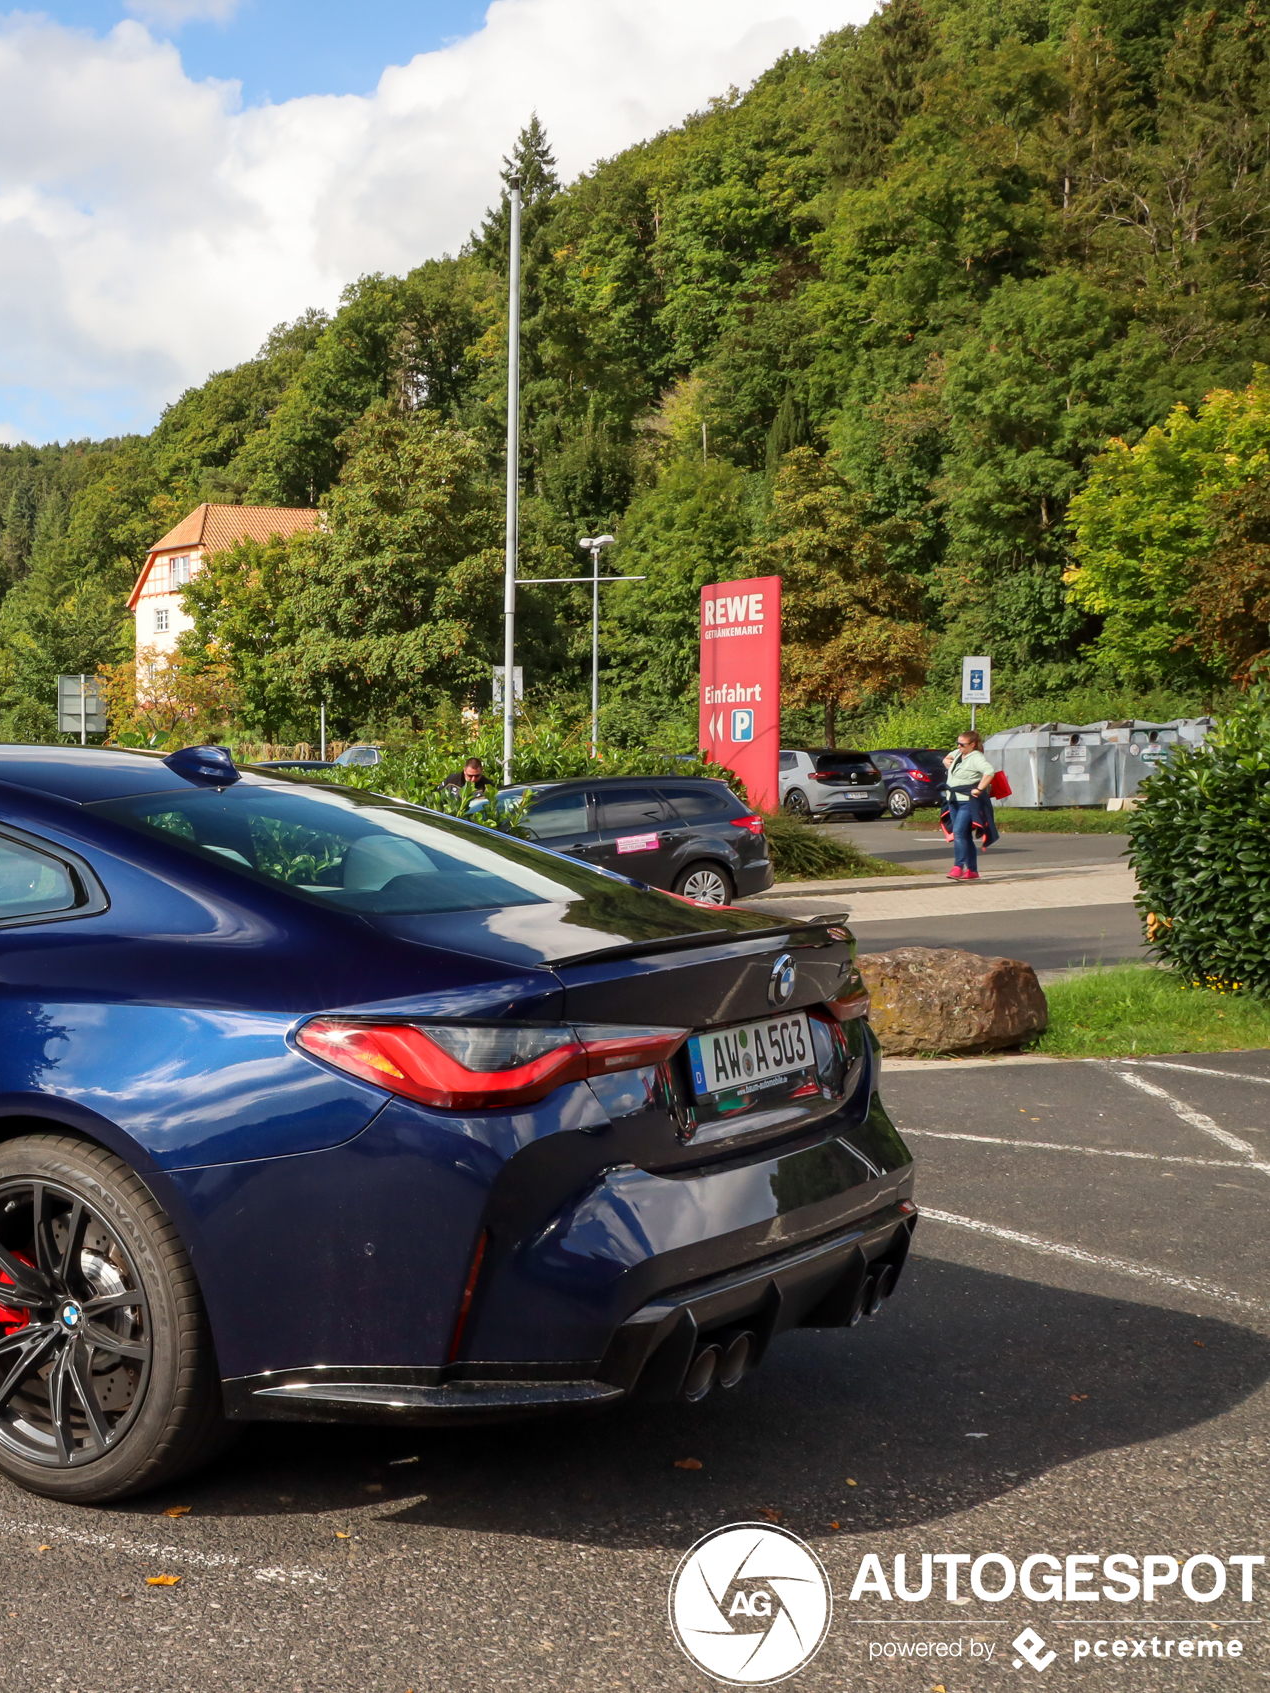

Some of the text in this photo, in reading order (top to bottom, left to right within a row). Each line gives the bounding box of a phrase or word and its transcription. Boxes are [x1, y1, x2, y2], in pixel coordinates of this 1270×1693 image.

[704, 593, 764, 627] REWE
[704, 624, 764, 640] GETRÄNKEMARKT
[704, 682, 762, 705] Einfahrt
[735, 711, 751, 740] P
[713, 1033, 741, 1083] AW
[767, 1019, 806, 1067] 503
[695, 1071, 703, 1084] D
[89, 1182, 148, 1254] ADVAN
